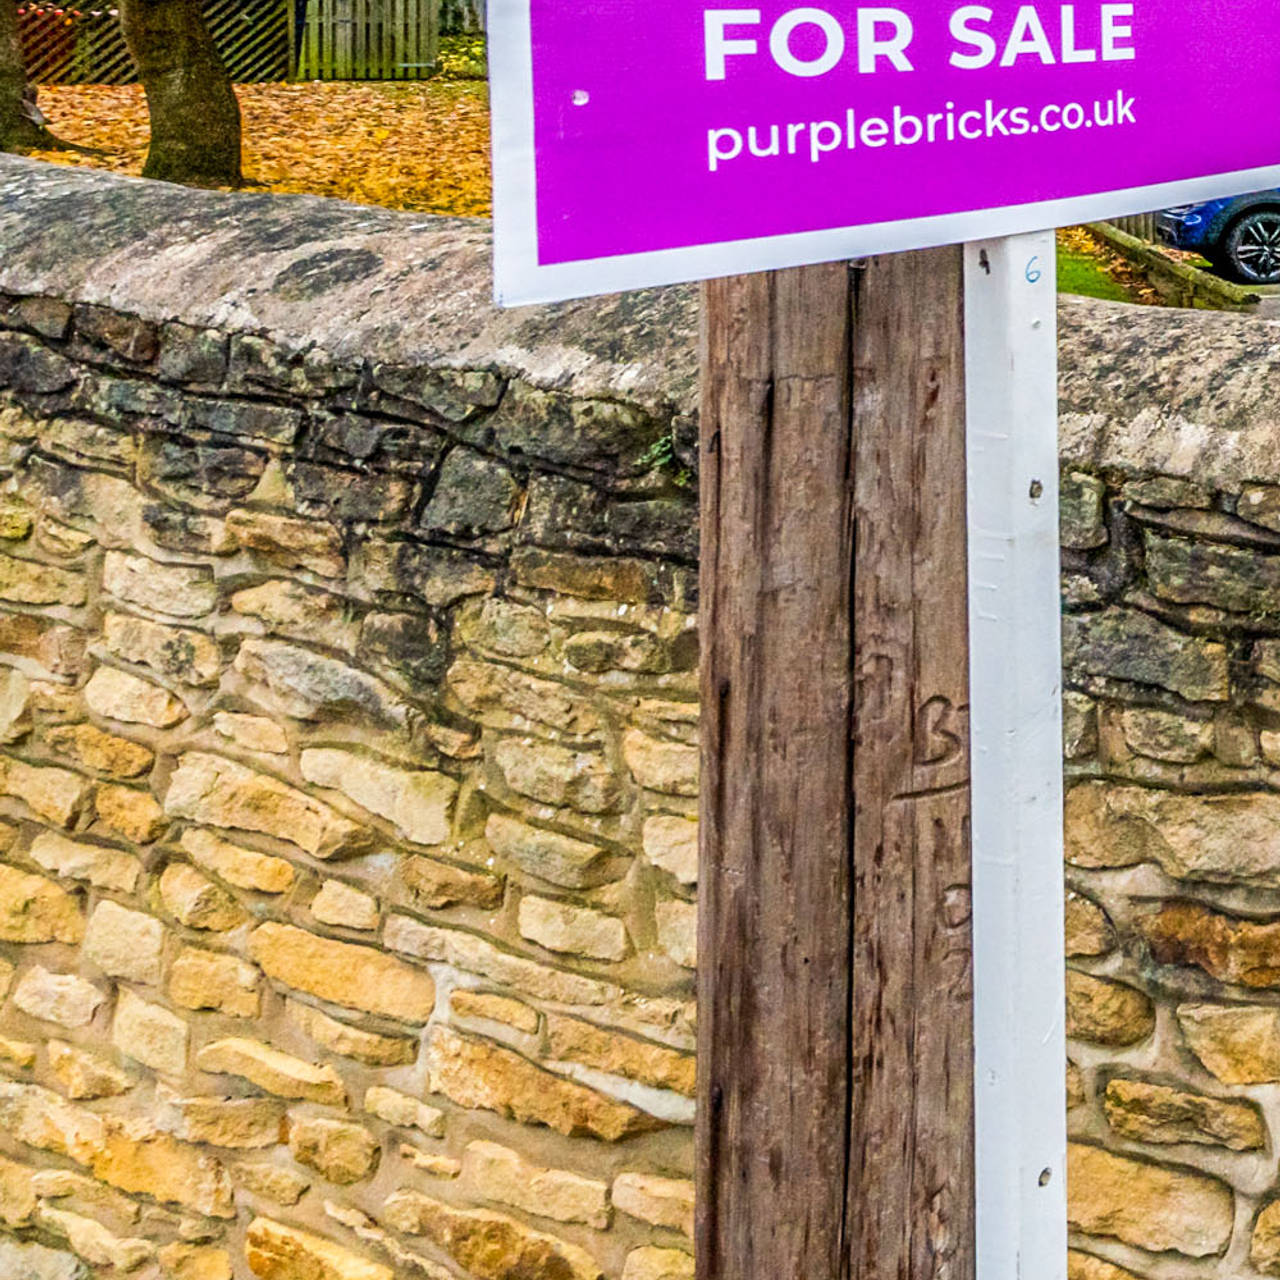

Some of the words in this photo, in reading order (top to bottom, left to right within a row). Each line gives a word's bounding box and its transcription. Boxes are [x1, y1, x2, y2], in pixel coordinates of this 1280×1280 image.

[704, 7, 914, 81] FOR
[949, 3, 1136, 69] SALE
[707, 89, 1137, 173] purplebricks.co.uk
[1026, 255, 1041, 283] 6
